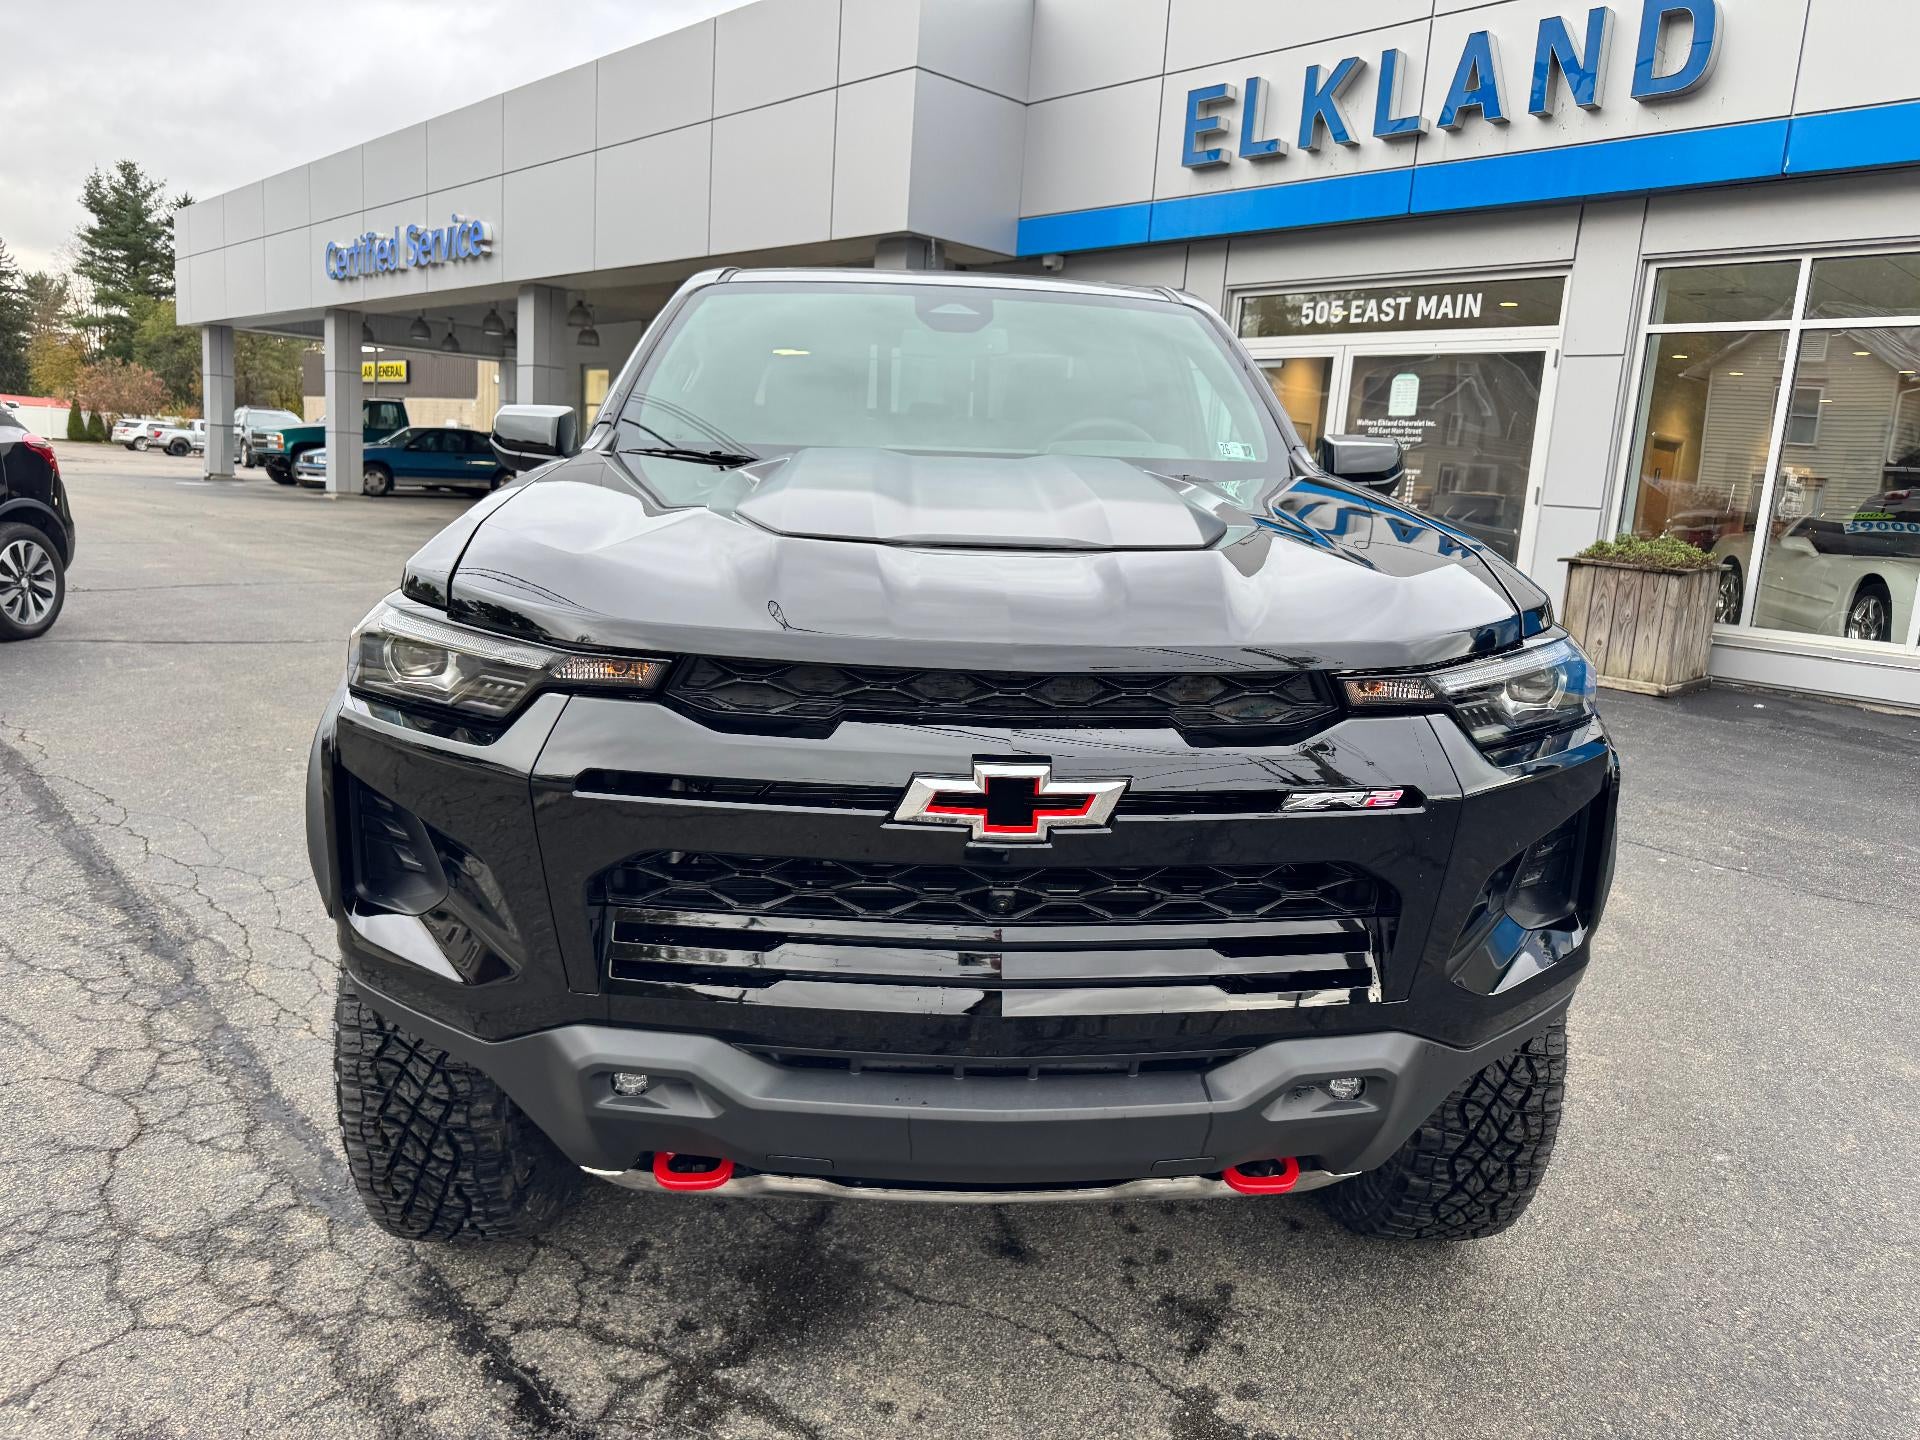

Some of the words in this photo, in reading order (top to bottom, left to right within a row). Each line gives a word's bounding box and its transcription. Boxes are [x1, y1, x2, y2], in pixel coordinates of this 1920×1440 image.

[1182, 0, 1725, 169] ELKLAND
[325, 225, 400, 280] Certified
[406, 213, 490, 267] Service
[1301, 299, 1344, 325] 505
[1349, 296, 1411, 323] EAST
[1415, 292, 1482, 320] MAIN
[378, 364, 404, 377] ENERAL
[1398, 419, 1425, 427] Chevrolet
[1405, 427, 1422, 435] Street
[1281, 789, 1405, 811] ZR2
